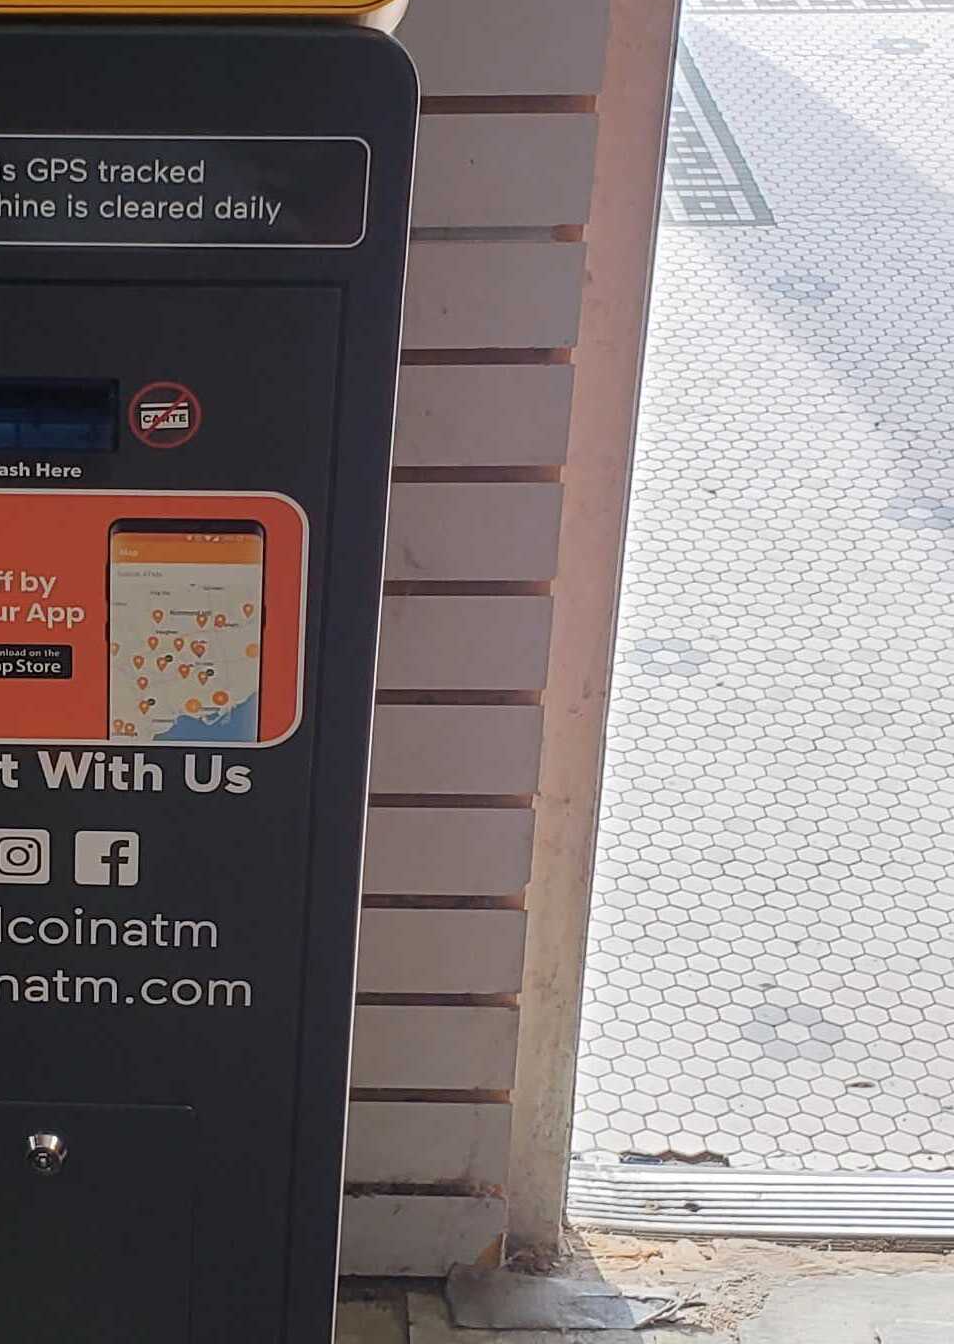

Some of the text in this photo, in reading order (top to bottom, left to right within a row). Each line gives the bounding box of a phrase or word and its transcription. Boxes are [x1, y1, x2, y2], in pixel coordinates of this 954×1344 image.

[26, 158, 88, 182] GPS
[97, 160, 206, 184] tracked
[66, 194, 88, 218] is
[98, 194, 204, 219] cleared
[213, 195, 282, 226] daily
[35, 462, 83, 479] Here
[19, 571, 57, 599] by
[25, 602, 86, 629] App
[45, 648, 61, 657] the
[16, 659, 62, 674] Store
[38, 750, 164, 792] With
[183, 753, 254, 795] Us
